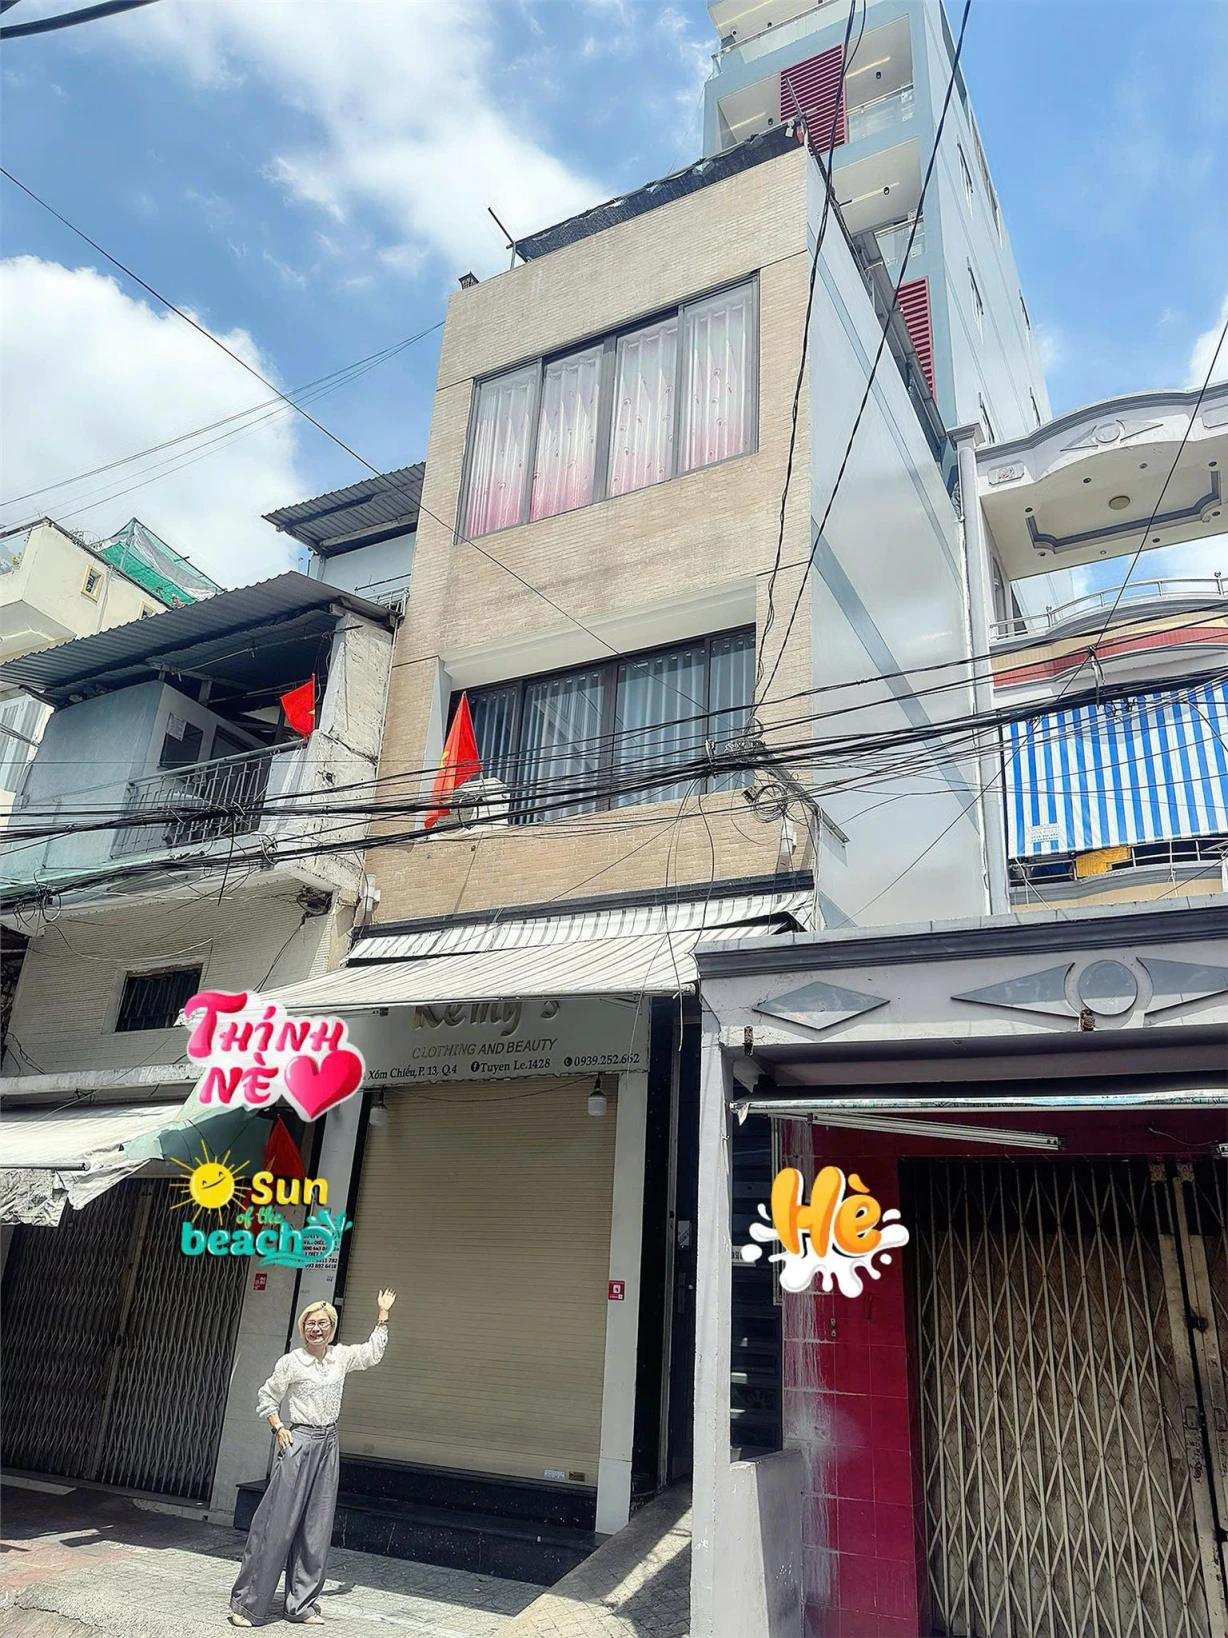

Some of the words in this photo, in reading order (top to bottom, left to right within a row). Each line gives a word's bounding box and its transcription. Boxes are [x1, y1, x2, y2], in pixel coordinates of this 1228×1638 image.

[412, 1043, 477, 1060] CLOTHING
[477, 1042, 505, 1056] AND
[506, 1038, 558, 1054] BEAUTY
[368, 1068, 388, 1080] Xóm
[480, 1062, 510, 1075] Tuyen
